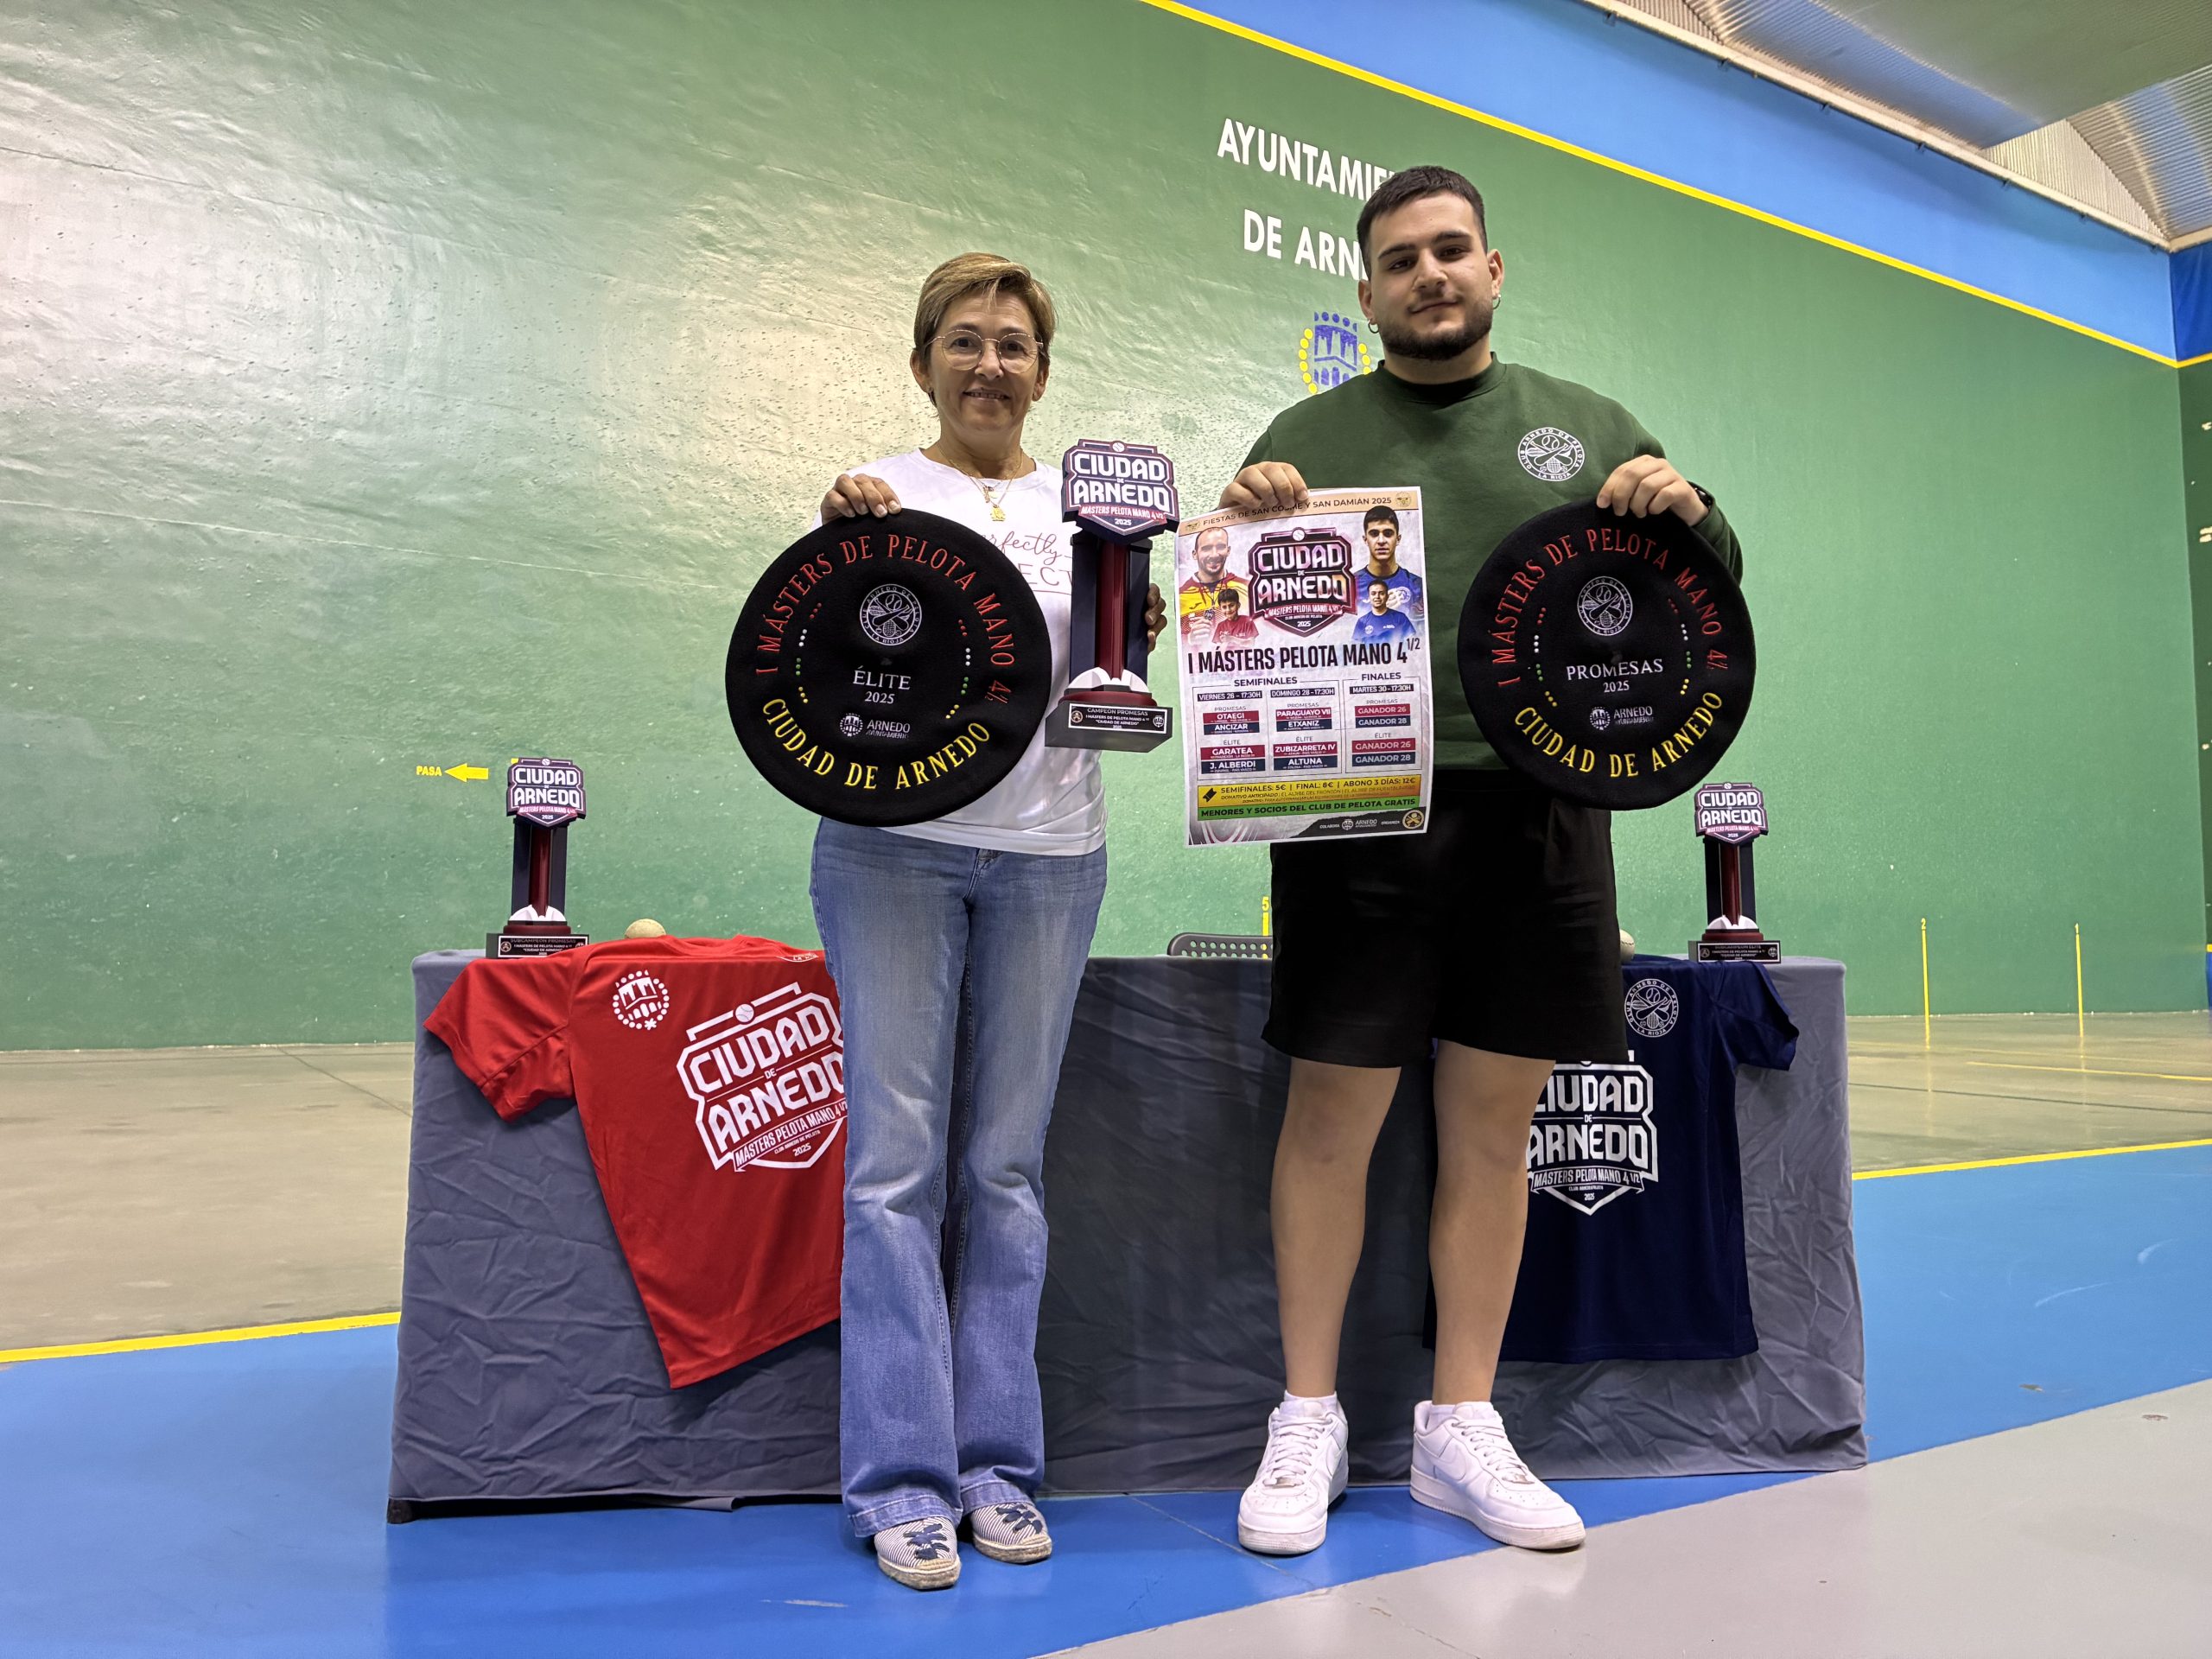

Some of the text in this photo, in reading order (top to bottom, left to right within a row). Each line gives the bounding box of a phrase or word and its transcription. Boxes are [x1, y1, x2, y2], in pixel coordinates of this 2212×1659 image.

[1217, 118, 1395, 202] AYUNTAMIE
[1243, 208, 1369, 281] DE ARN
[1074, 453, 1166, 480] CIUDAD
[1073, 480, 1170, 512] ARNEDO
[1081, 506, 1110, 515] MASTERS
[1110, 506, 1132, 516] PELOTA
[1132, 508, 1150, 518] MANO
[1203, 514, 1236, 525] FIESTAS
[1333, 498, 1370, 506] DAMIÁN
[1257, 543, 1344, 571] CIUDAD
[1257, 575, 1347, 605] ARNEDO
[1487, 559, 1547, 664] MÁSTERS
[1543, 535, 1579, 565] DE
[1586, 528, 1669, 570] PELOTA
[1674, 567, 1722, 636] MANO
[757, 553, 833, 652] MÁSTERS
[839, 536, 873, 565] DE
[887, 534, 978, 591] PELOTA
[973, 593, 1015, 666] MANO
[1293, 605, 1312, 613] PELOTA
[1188, 653, 1193, 674] I
[1198, 646, 1275, 673] MÁSTERS
[1280, 645, 1338, 669] PELOTA
[1343, 642, 1391, 665] MANO
[853, 665, 912, 690] ÉLITE
[1361, 672, 1402, 681] FINALES
[1566, 658, 1663, 681] PROMESAS
[1234, 677, 1298, 687] SEMIFINALES
[1603, 680, 1630, 692] 2025
[864, 691, 895, 704] 2025
[1276, 709, 1321, 717] PARAGUAYO
[1613, 706, 1653, 719] ARNEDO
[867, 719, 911, 734] ARNEDO
[1514, 692, 1723, 778] CIUDAD DE ARNEDO
[762, 698, 990, 790] CIUDAD DE ARNEDO
[1274, 744, 1327, 753] ZUBIZARRETA
[1218, 760, 1256, 769] ALBERDI
[1356, 755, 1399, 764] GANADOR
[416, 766, 442, 777] PASA
[515, 768, 577, 785] CIUDAD
[1381, 777, 1401, 785] DÍAS:
[514, 788, 580, 808] ARNEDO
[1700, 791, 1758, 807] CIUDAD
[1201, 808, 1244, 817] MENORES
[1254, 805, 1287, 814] SOCIOS
[1701, 810, 1763, 828] ARNEDO
[1262, 896, 1269, 912] 5
[1921, 918, 1926, 929] 2
[1629, 980, 1657, 997] ARNEDO
[690, 1005, 830, 1093] CIUDAD
[764, 1068, 777, 1079] DE
[1535, 1075, 1643, 1112] IUDAD
[1584, 1114, 1592, 1122] DE
[735, 1132, 776, 1167] MASTERS
[775, 1117, 809, 1142] PELOTA
[805, 1107, 836, 1127] MANO
[792, 1142, 811, 1157] 2025
[1527, 1124, 1649, 1170] ARNEDO
[1534, 1169, 1573, 1188] MASTERS
[1575, 1168, 1598, 1183] PELOTA
[1598, 1168, 1621, 1184] MANO
[1584, 1192, 1595, 1201] 2025
